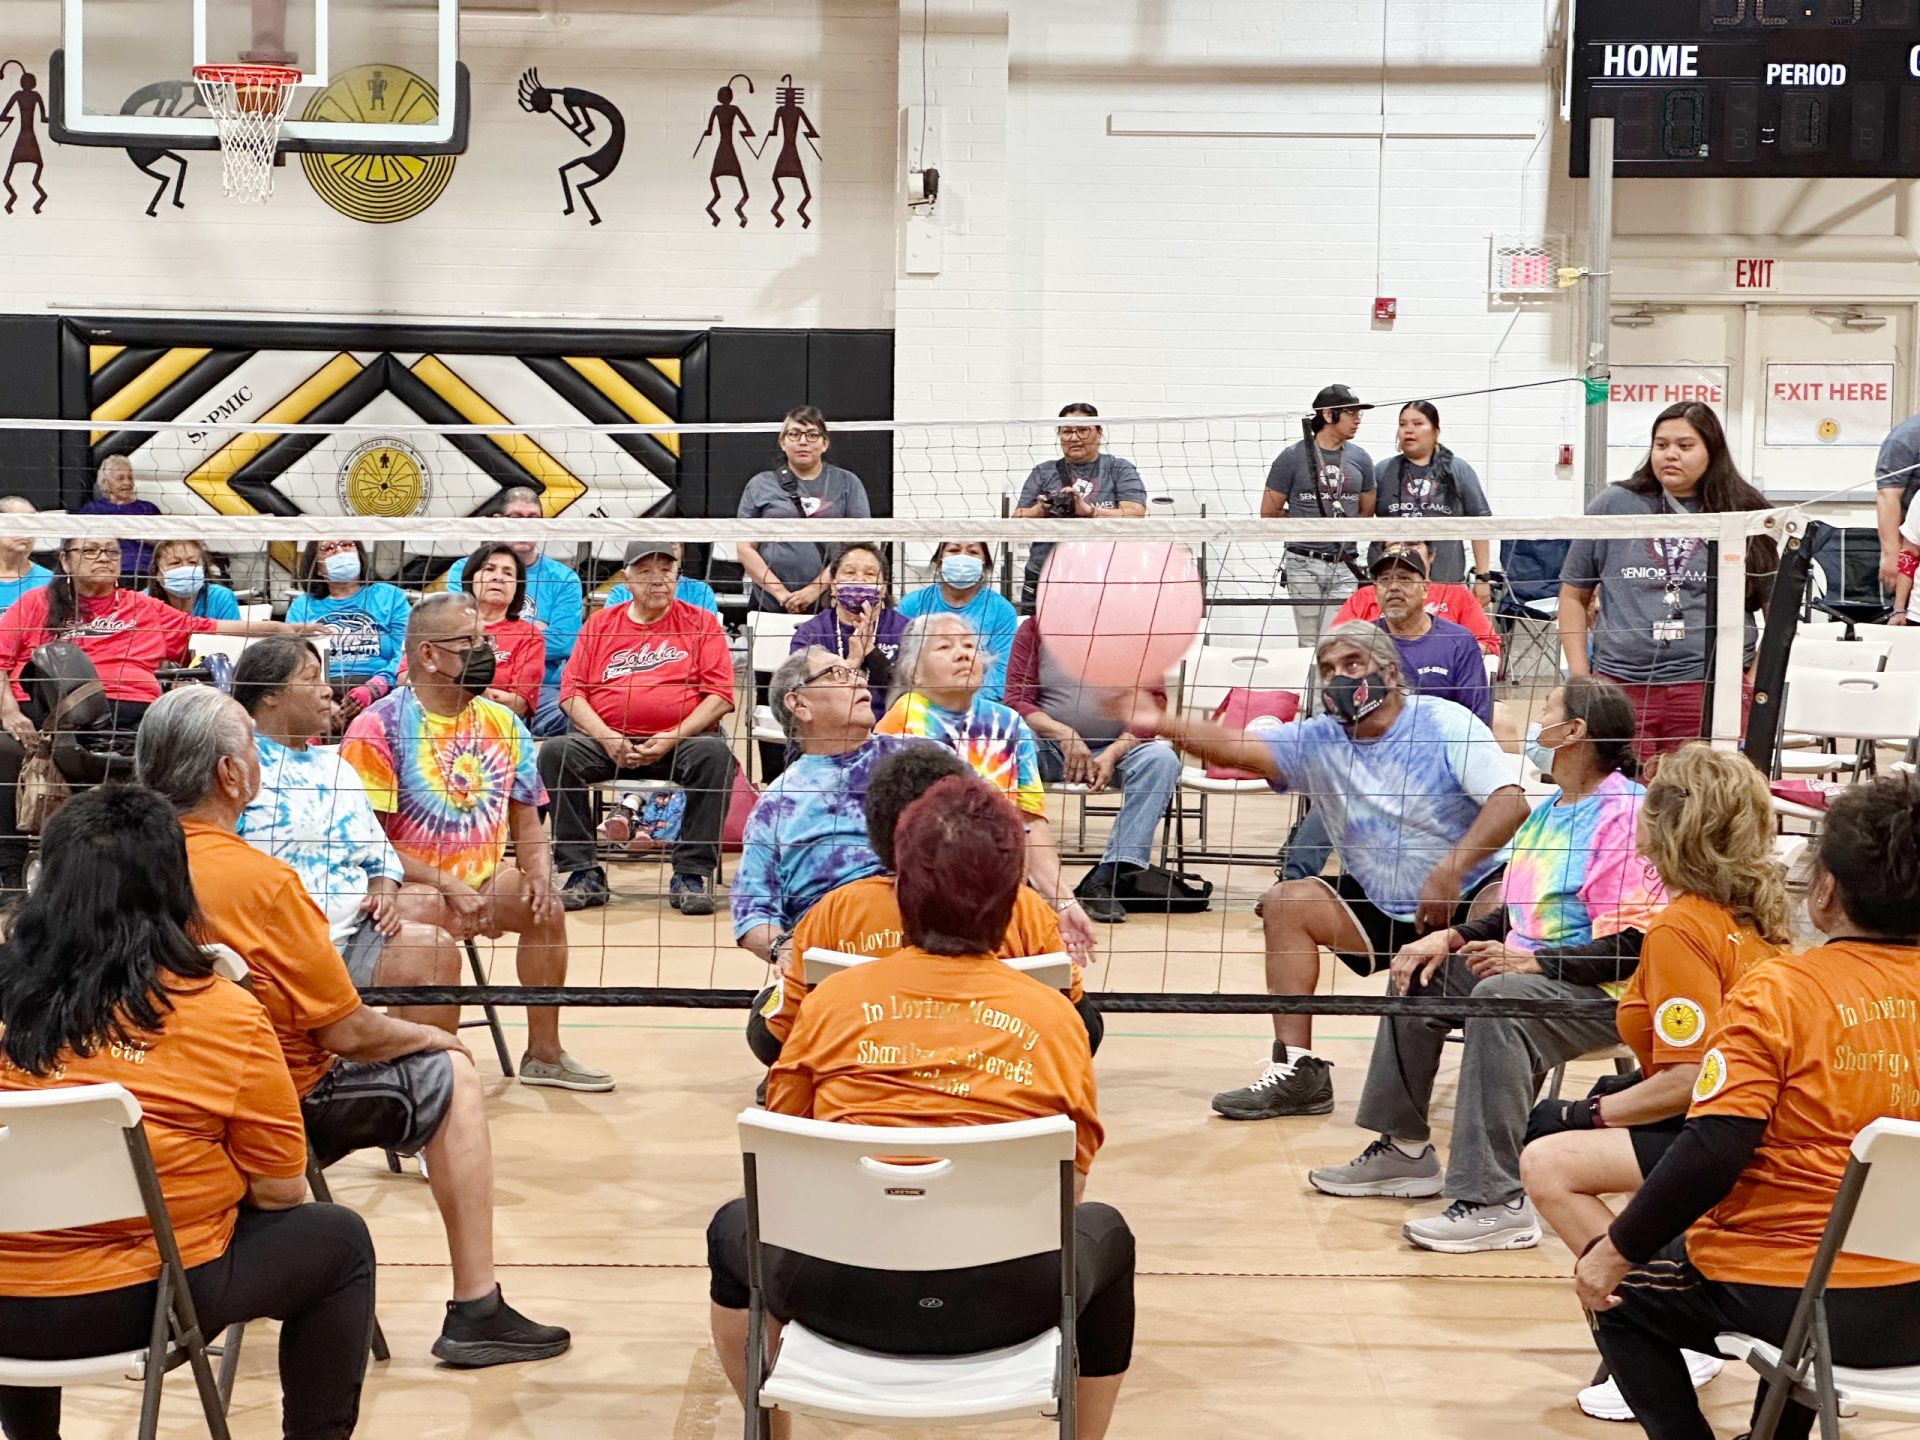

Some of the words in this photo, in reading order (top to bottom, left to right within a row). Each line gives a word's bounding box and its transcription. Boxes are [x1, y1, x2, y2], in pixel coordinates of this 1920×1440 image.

[1603, 45, 1699, 77] HOME
[1766, 64, 1847, 86] PERIOD
[1736, 259, 1774, 288] EXIT
[1609, 385, 1659, 402] EXIT
[1664, 384, 1722, 402] HERE
[1774, 383, 1823, 401] EXIT
[1829, 383, 1888, 401] HERE
[608, 640, 688, 668] Soboba
[860, 928, 901, 953] Lovin
[861, 1001, 884, 1025] In
[967, 1000, 1041, 1051] Memory
[1837, 1003, 1859, 1029] In
